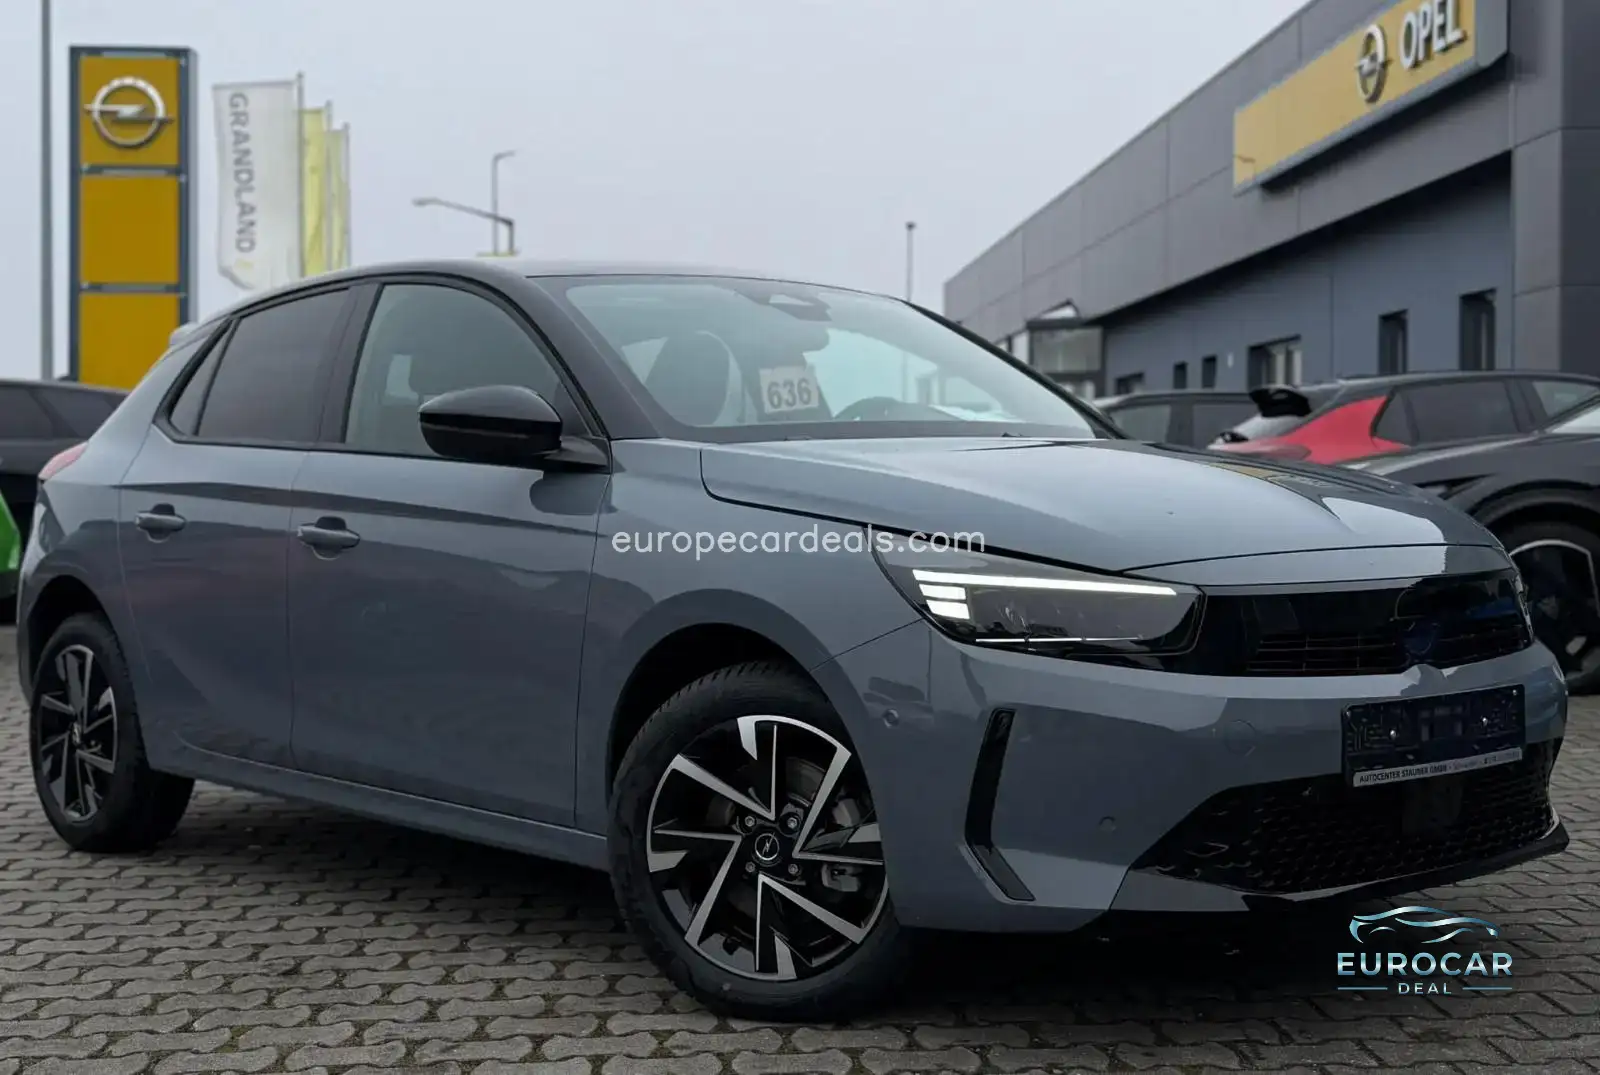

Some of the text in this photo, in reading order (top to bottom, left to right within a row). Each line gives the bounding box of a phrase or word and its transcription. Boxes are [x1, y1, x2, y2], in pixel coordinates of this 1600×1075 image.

[1399, 0, 1464, 70] OPEL
[228, 92, 257, 254] GRANDLAND
[768, 378, 812, 410] 636
[1359, 770, 1401, 783] AUTOCENTER
